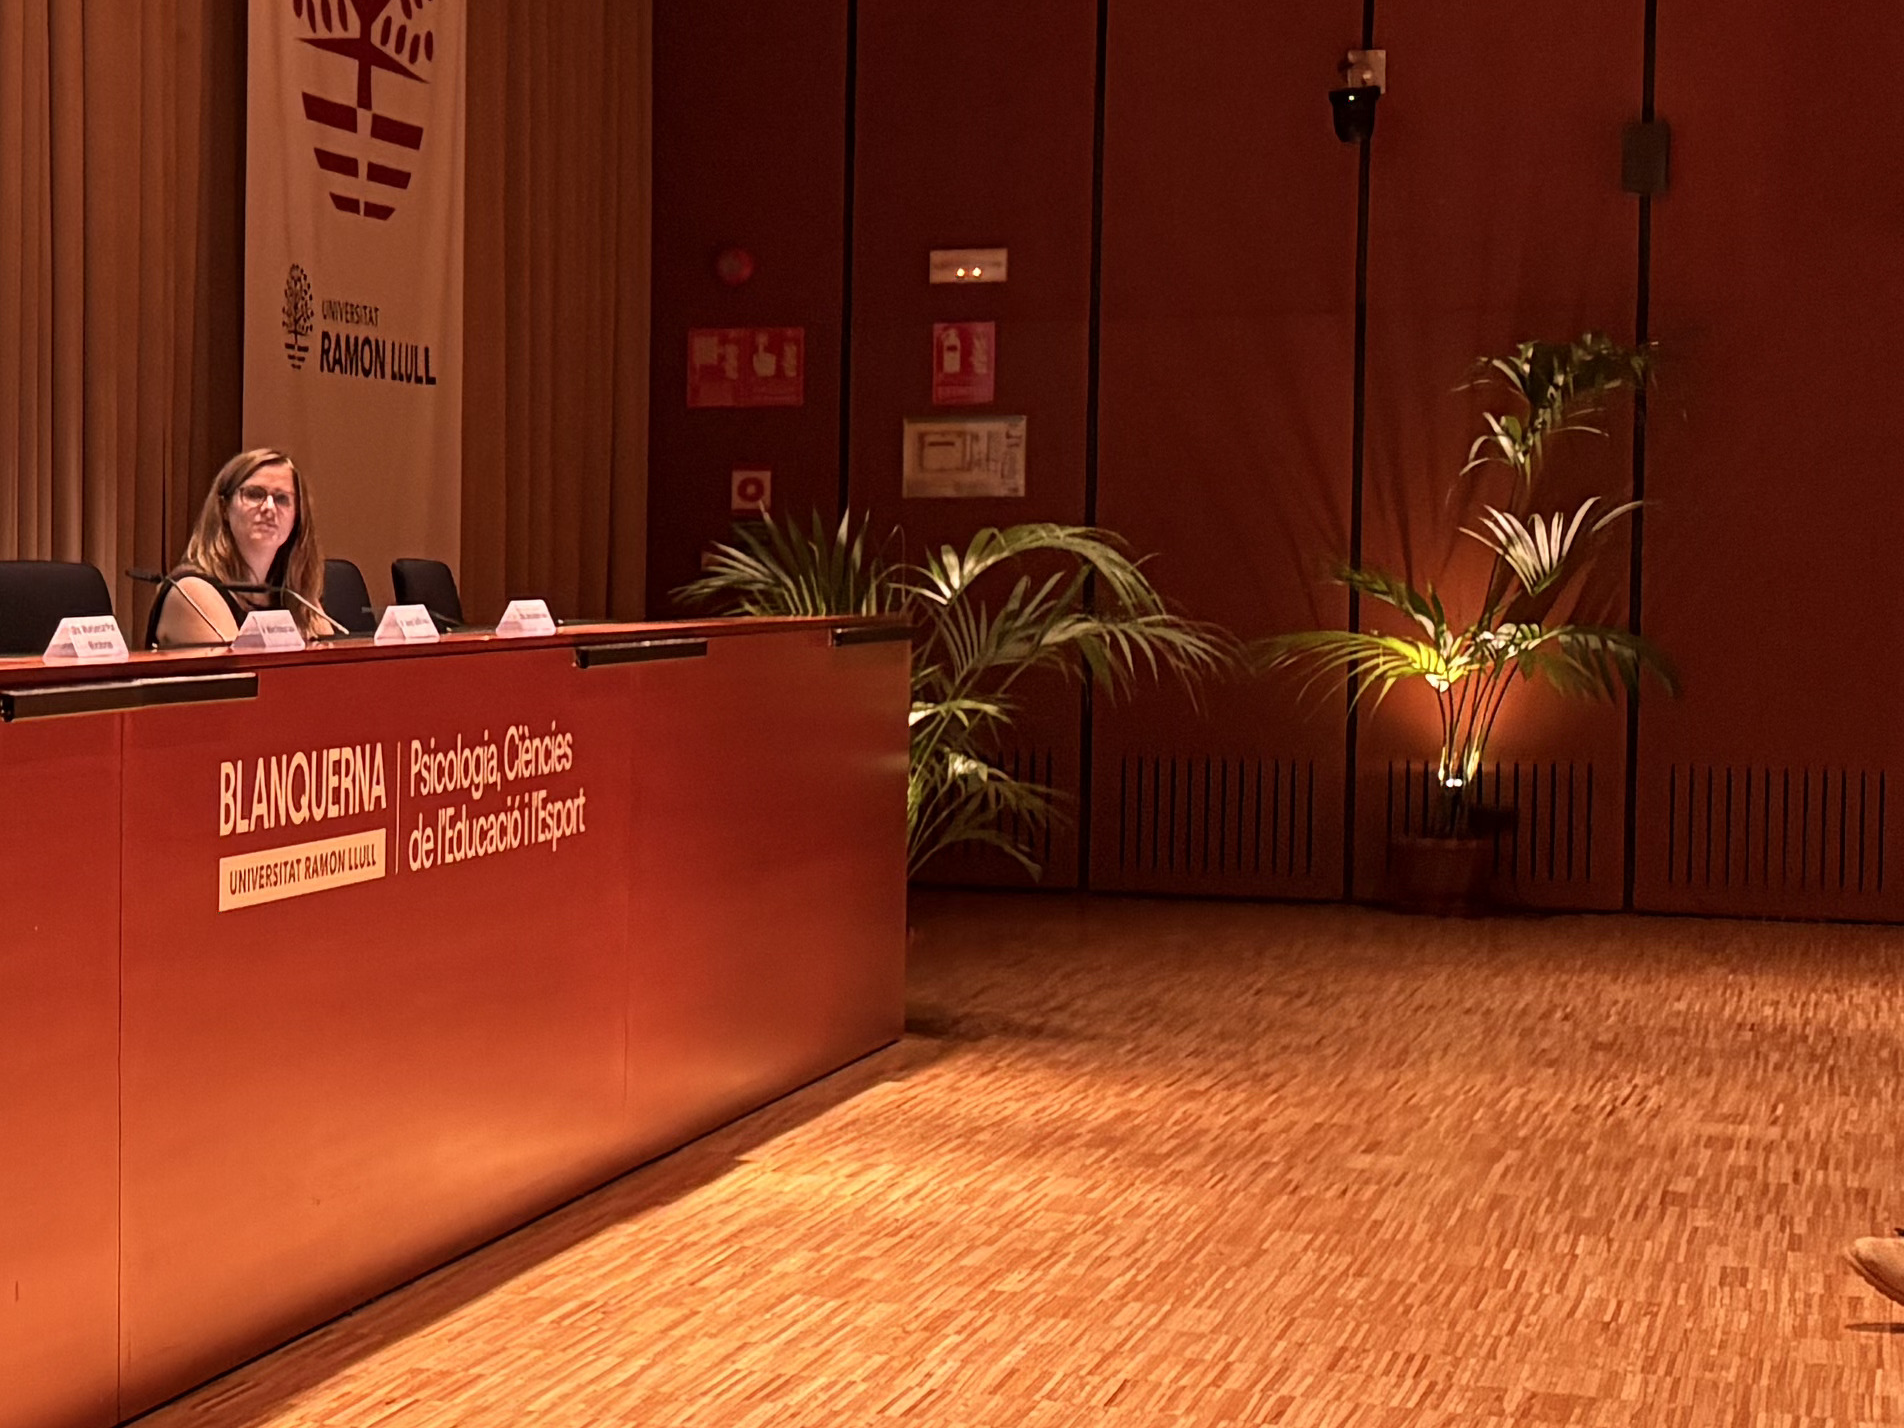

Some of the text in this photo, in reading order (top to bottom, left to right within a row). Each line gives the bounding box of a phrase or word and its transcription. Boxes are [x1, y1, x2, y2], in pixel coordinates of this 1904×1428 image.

[321, 299, 380, 328] UNIVERSITAT
[319, 330, 437, 386] RAMON LLULL
[219, 742, 387, 837] BLANQUERNA
[410, 720, 574, 800] Psicologia, Ciències
[408, 787, 587, 872] de l'Educació i l'Esport
[228, 842, 378, 896] UNIVERSITAT RAMON LLULL
